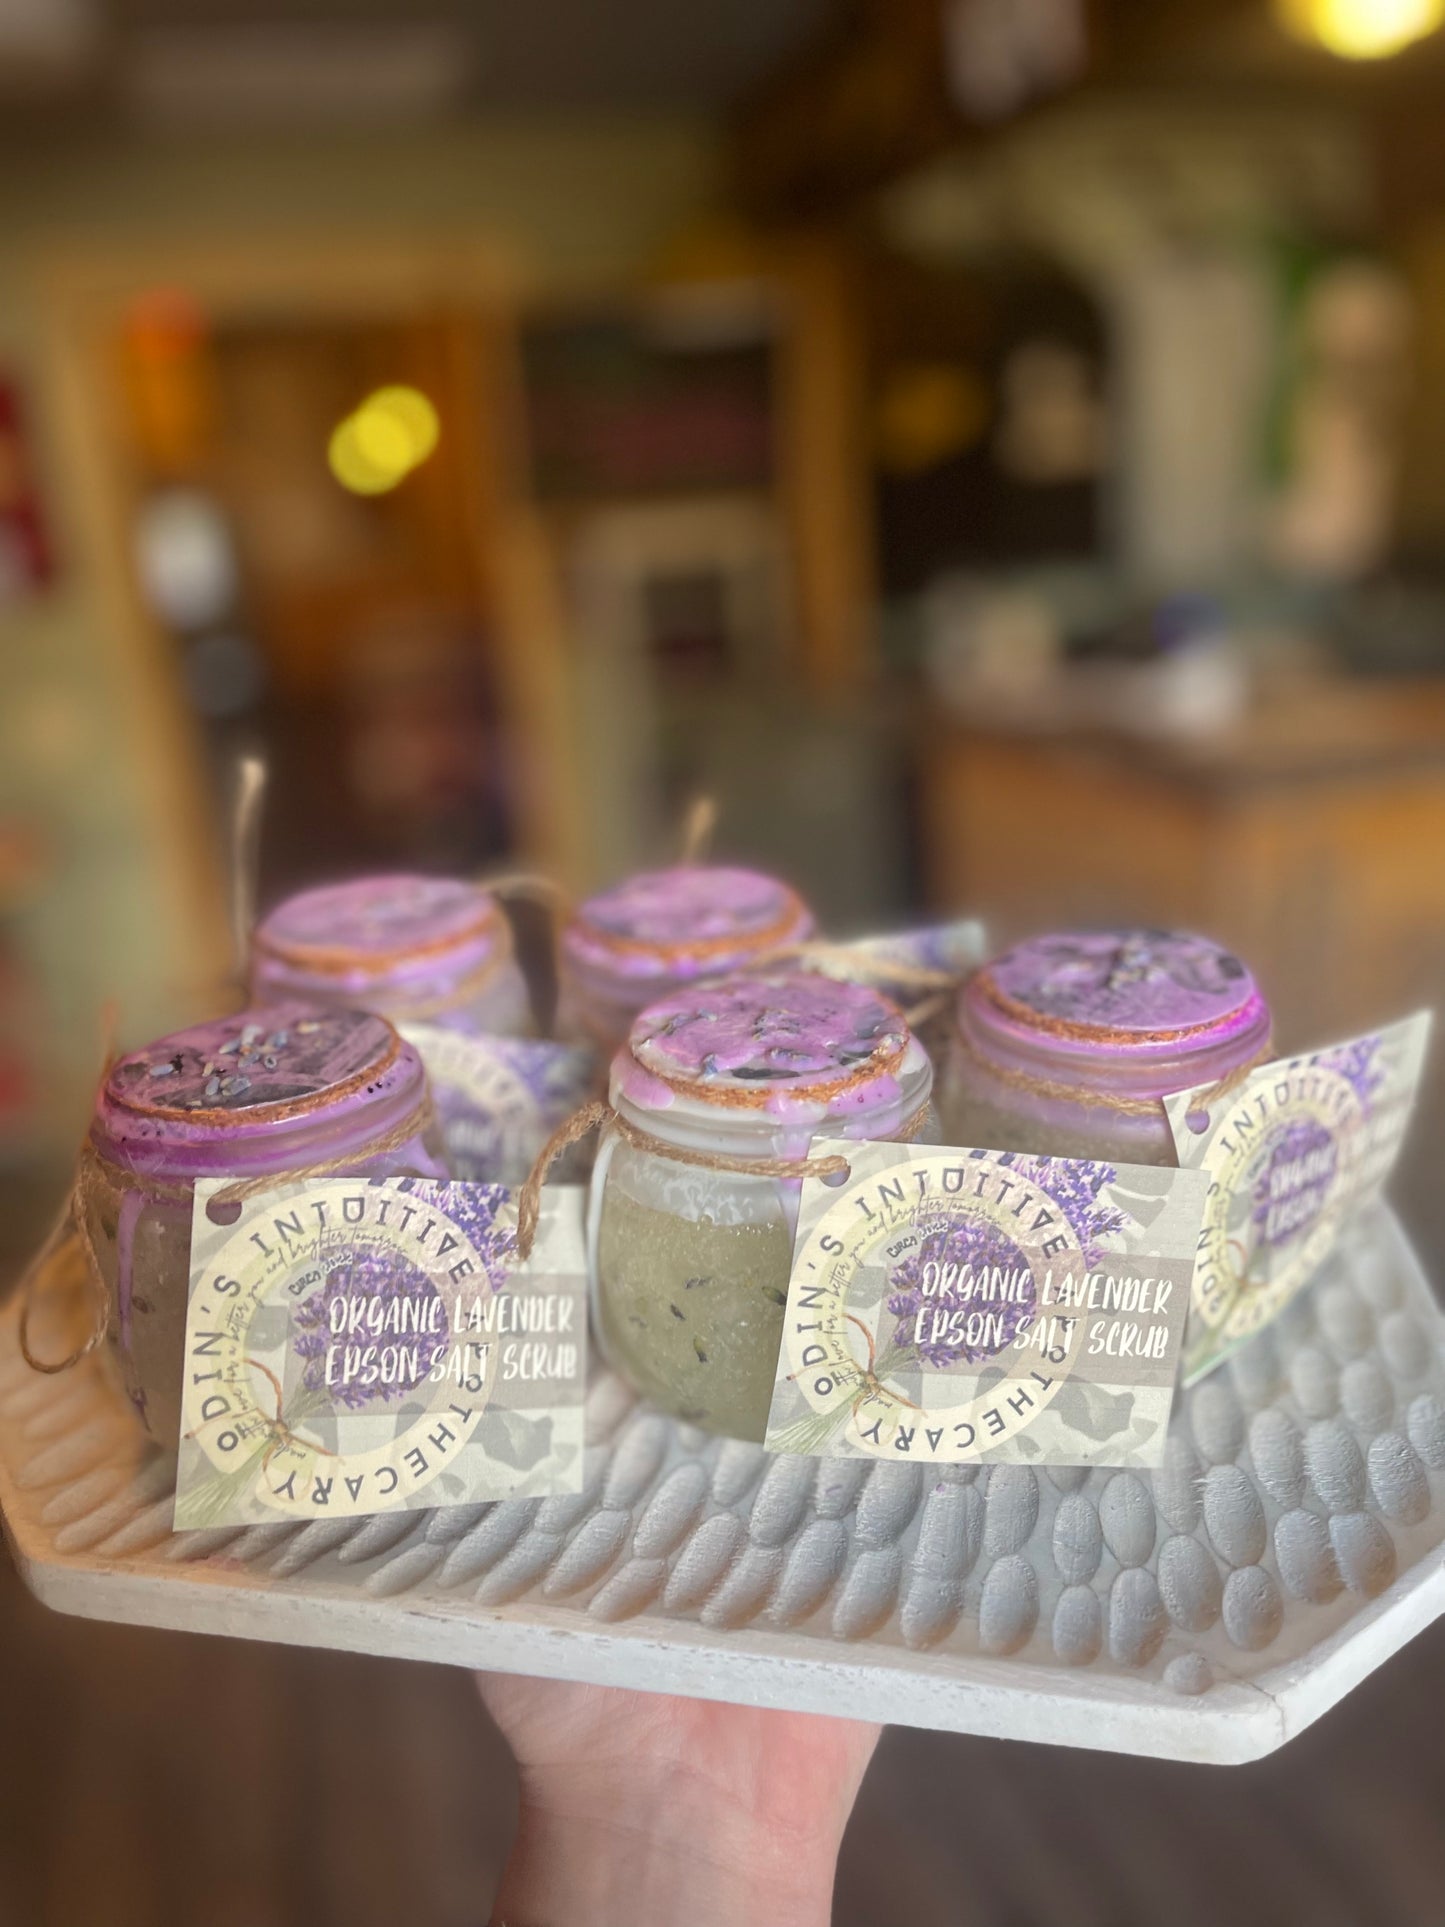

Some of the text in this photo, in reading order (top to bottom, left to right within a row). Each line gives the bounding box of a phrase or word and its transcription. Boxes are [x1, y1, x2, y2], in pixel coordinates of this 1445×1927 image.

[825, 1262, 852, 1297] better
[849, 1238, 866, 1269] you
[867, 1211, 889, 1236] and
[887, 1194, 944, 1228] brighter
[886, 1235, 917, 1258] CIRCA
[223, 1302, 251, 1341] better
[248, 1276, 265, 1309] you
[266, 1247, 290, 1274] and
[287, 1225, 347, 1262] brighter
[288, 1270, 321, 1296] CIRCA
[797, 1234, 844, 1397] ODIN'S
[855, 1168, 1069, 1260] INTUITIVE
[921, 1261, 1173, 1315] ORGANIC LAVENDER
[193, 1275, 241, 1451] ODIN'S
[250, 1197, 474, 1284] INTUITIVE
[329, 1294, 575, 1336] ORGANIC LAVENDER
[914, 1307, 1170, 1359] EPSON SALT SCRUB
[324, 1343, 577, 1386] EPSON SALT SCRUB
